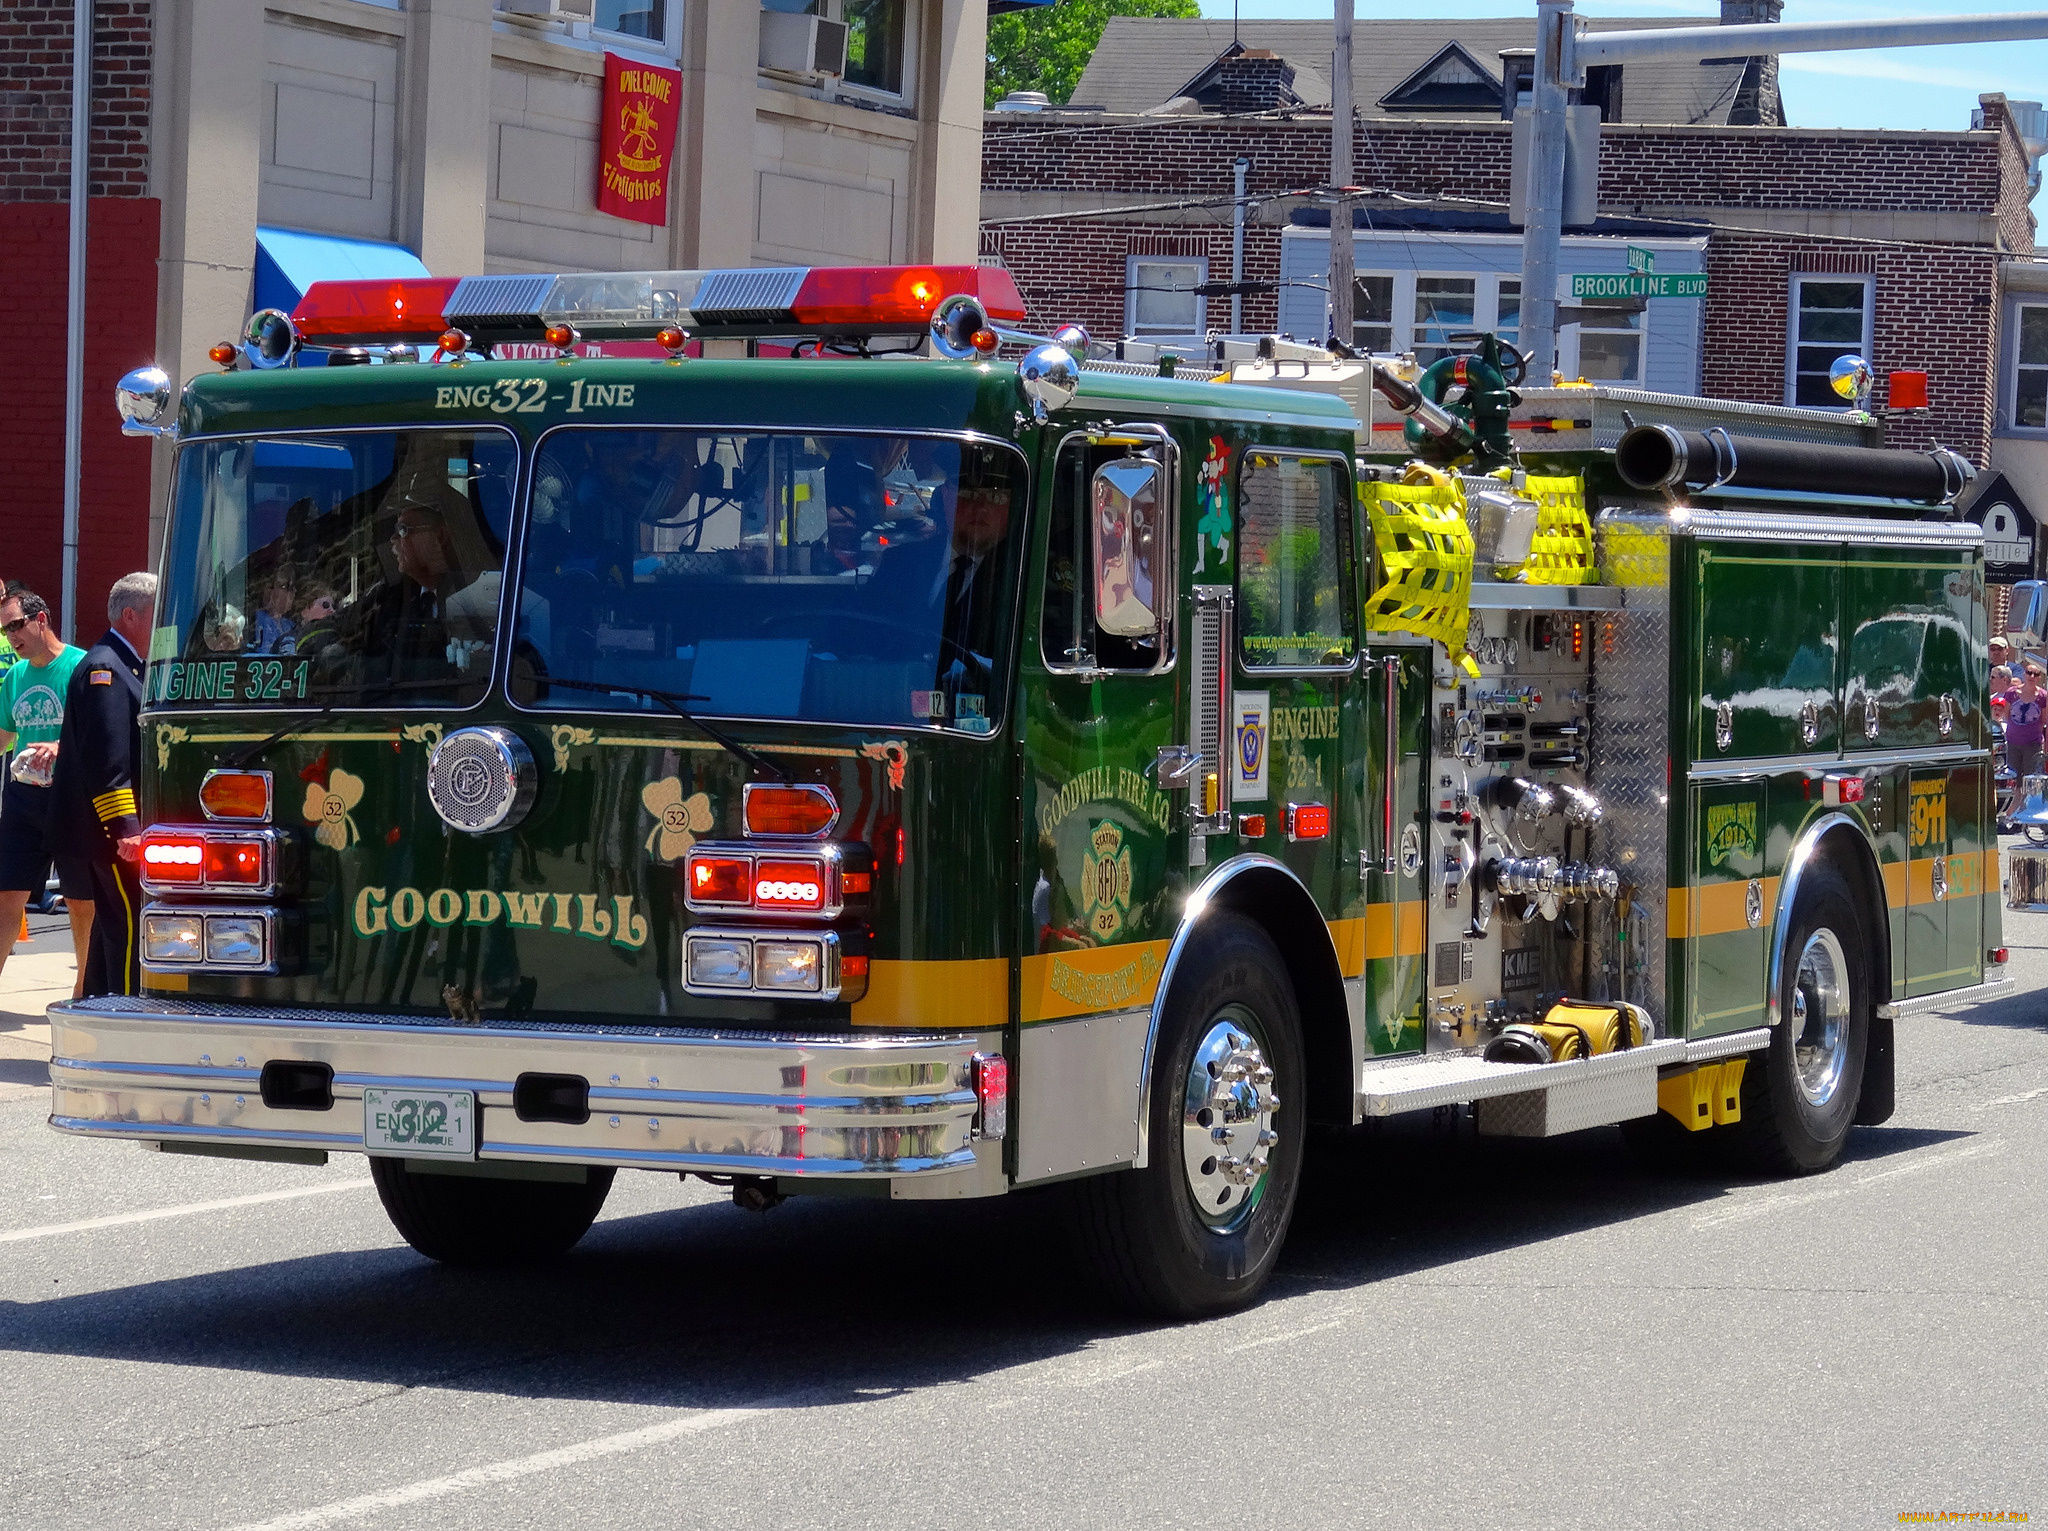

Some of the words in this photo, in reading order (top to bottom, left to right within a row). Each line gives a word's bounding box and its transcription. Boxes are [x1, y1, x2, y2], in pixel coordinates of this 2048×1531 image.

[1574, 277, 1669, 296] BROOKLINE
[1677, 280, 1707, 294] BLVD
[244, 660, 309, 700] 32-1
[932, 693, 941, 715] 12
[960, 697, 967, 715] 9
[1272, 706, 1340, 740] ENGINE
[1287, 753, 1323, 789] 32-1
[325, 803, 343, 817] 32
[1042, 765, 1114, 836] GOODWILL
[1117, 766, 1149, 812] FIRE
[666, 811, 686, 826] 32
[1915, 794, 1947, 847] 911
[1095, 832, 1120, 850] STATION
[1098, 858, 1118, 905] BFD
[1949, 857, 1976, 894] 32-1
[352, 886, 648, 951] GOODWILL
[1099, 914, 1114, 930] 32
[1505, 952, 1540, 977] KME
[375, 1112, 448, 1133] ENGINE
[454, 1116, 462, 1133] 1
[391, 1099, 448, 1144] 32
